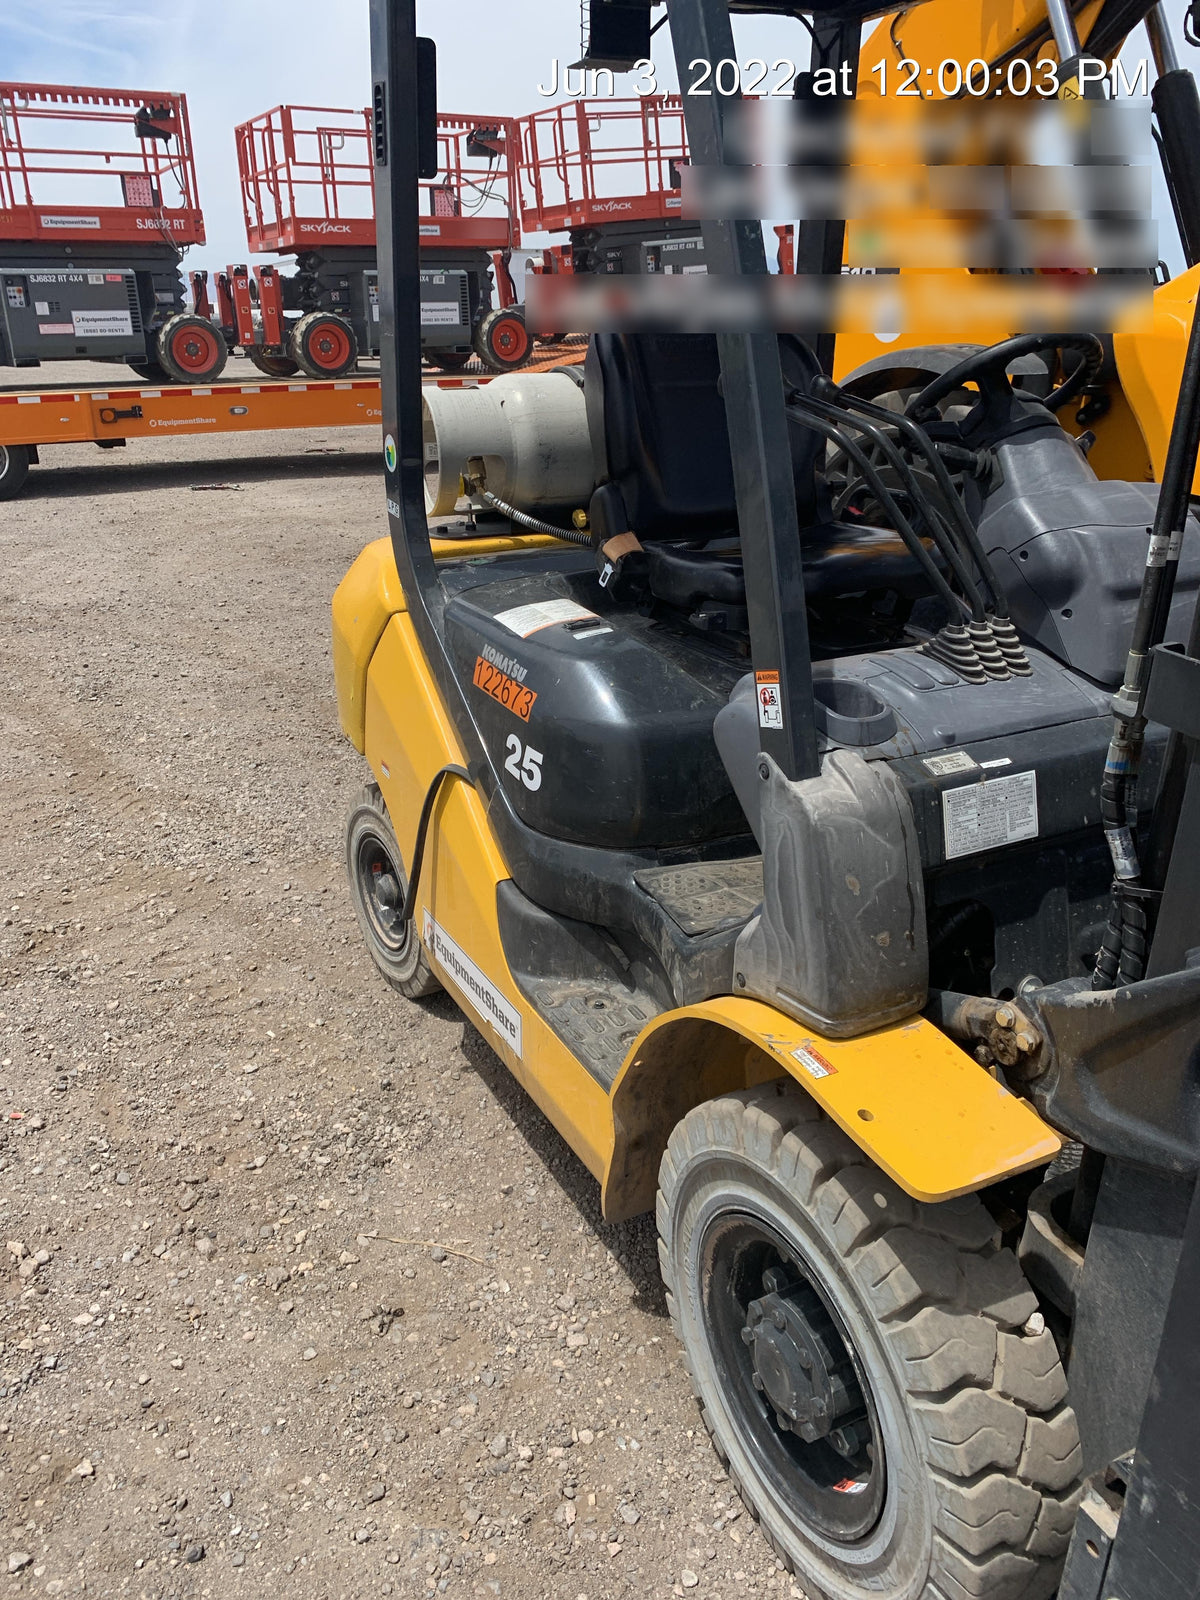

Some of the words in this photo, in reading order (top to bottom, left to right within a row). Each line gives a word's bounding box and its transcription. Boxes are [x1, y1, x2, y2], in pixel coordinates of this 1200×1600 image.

[592, 201, 632, 211] SKYJACK
[136, 218, 172, 229] SJ6832
[173, 219, 186, 229] RT
[300, 221, 351, 233] SKYJACK
[30, 275, 57, 283] SJ6832
[58, 275, 68, 283] RT
[69, 275, 84, 283] 4X4
[157, 418, 216, 426] EquipmentShare
[481, 643, 528, 682] KOMATSU
[475, 659, 535, 719] 122673
[504, 733, 544, 792] 25
[435, 931, 517, 1038] EquipmentShare
